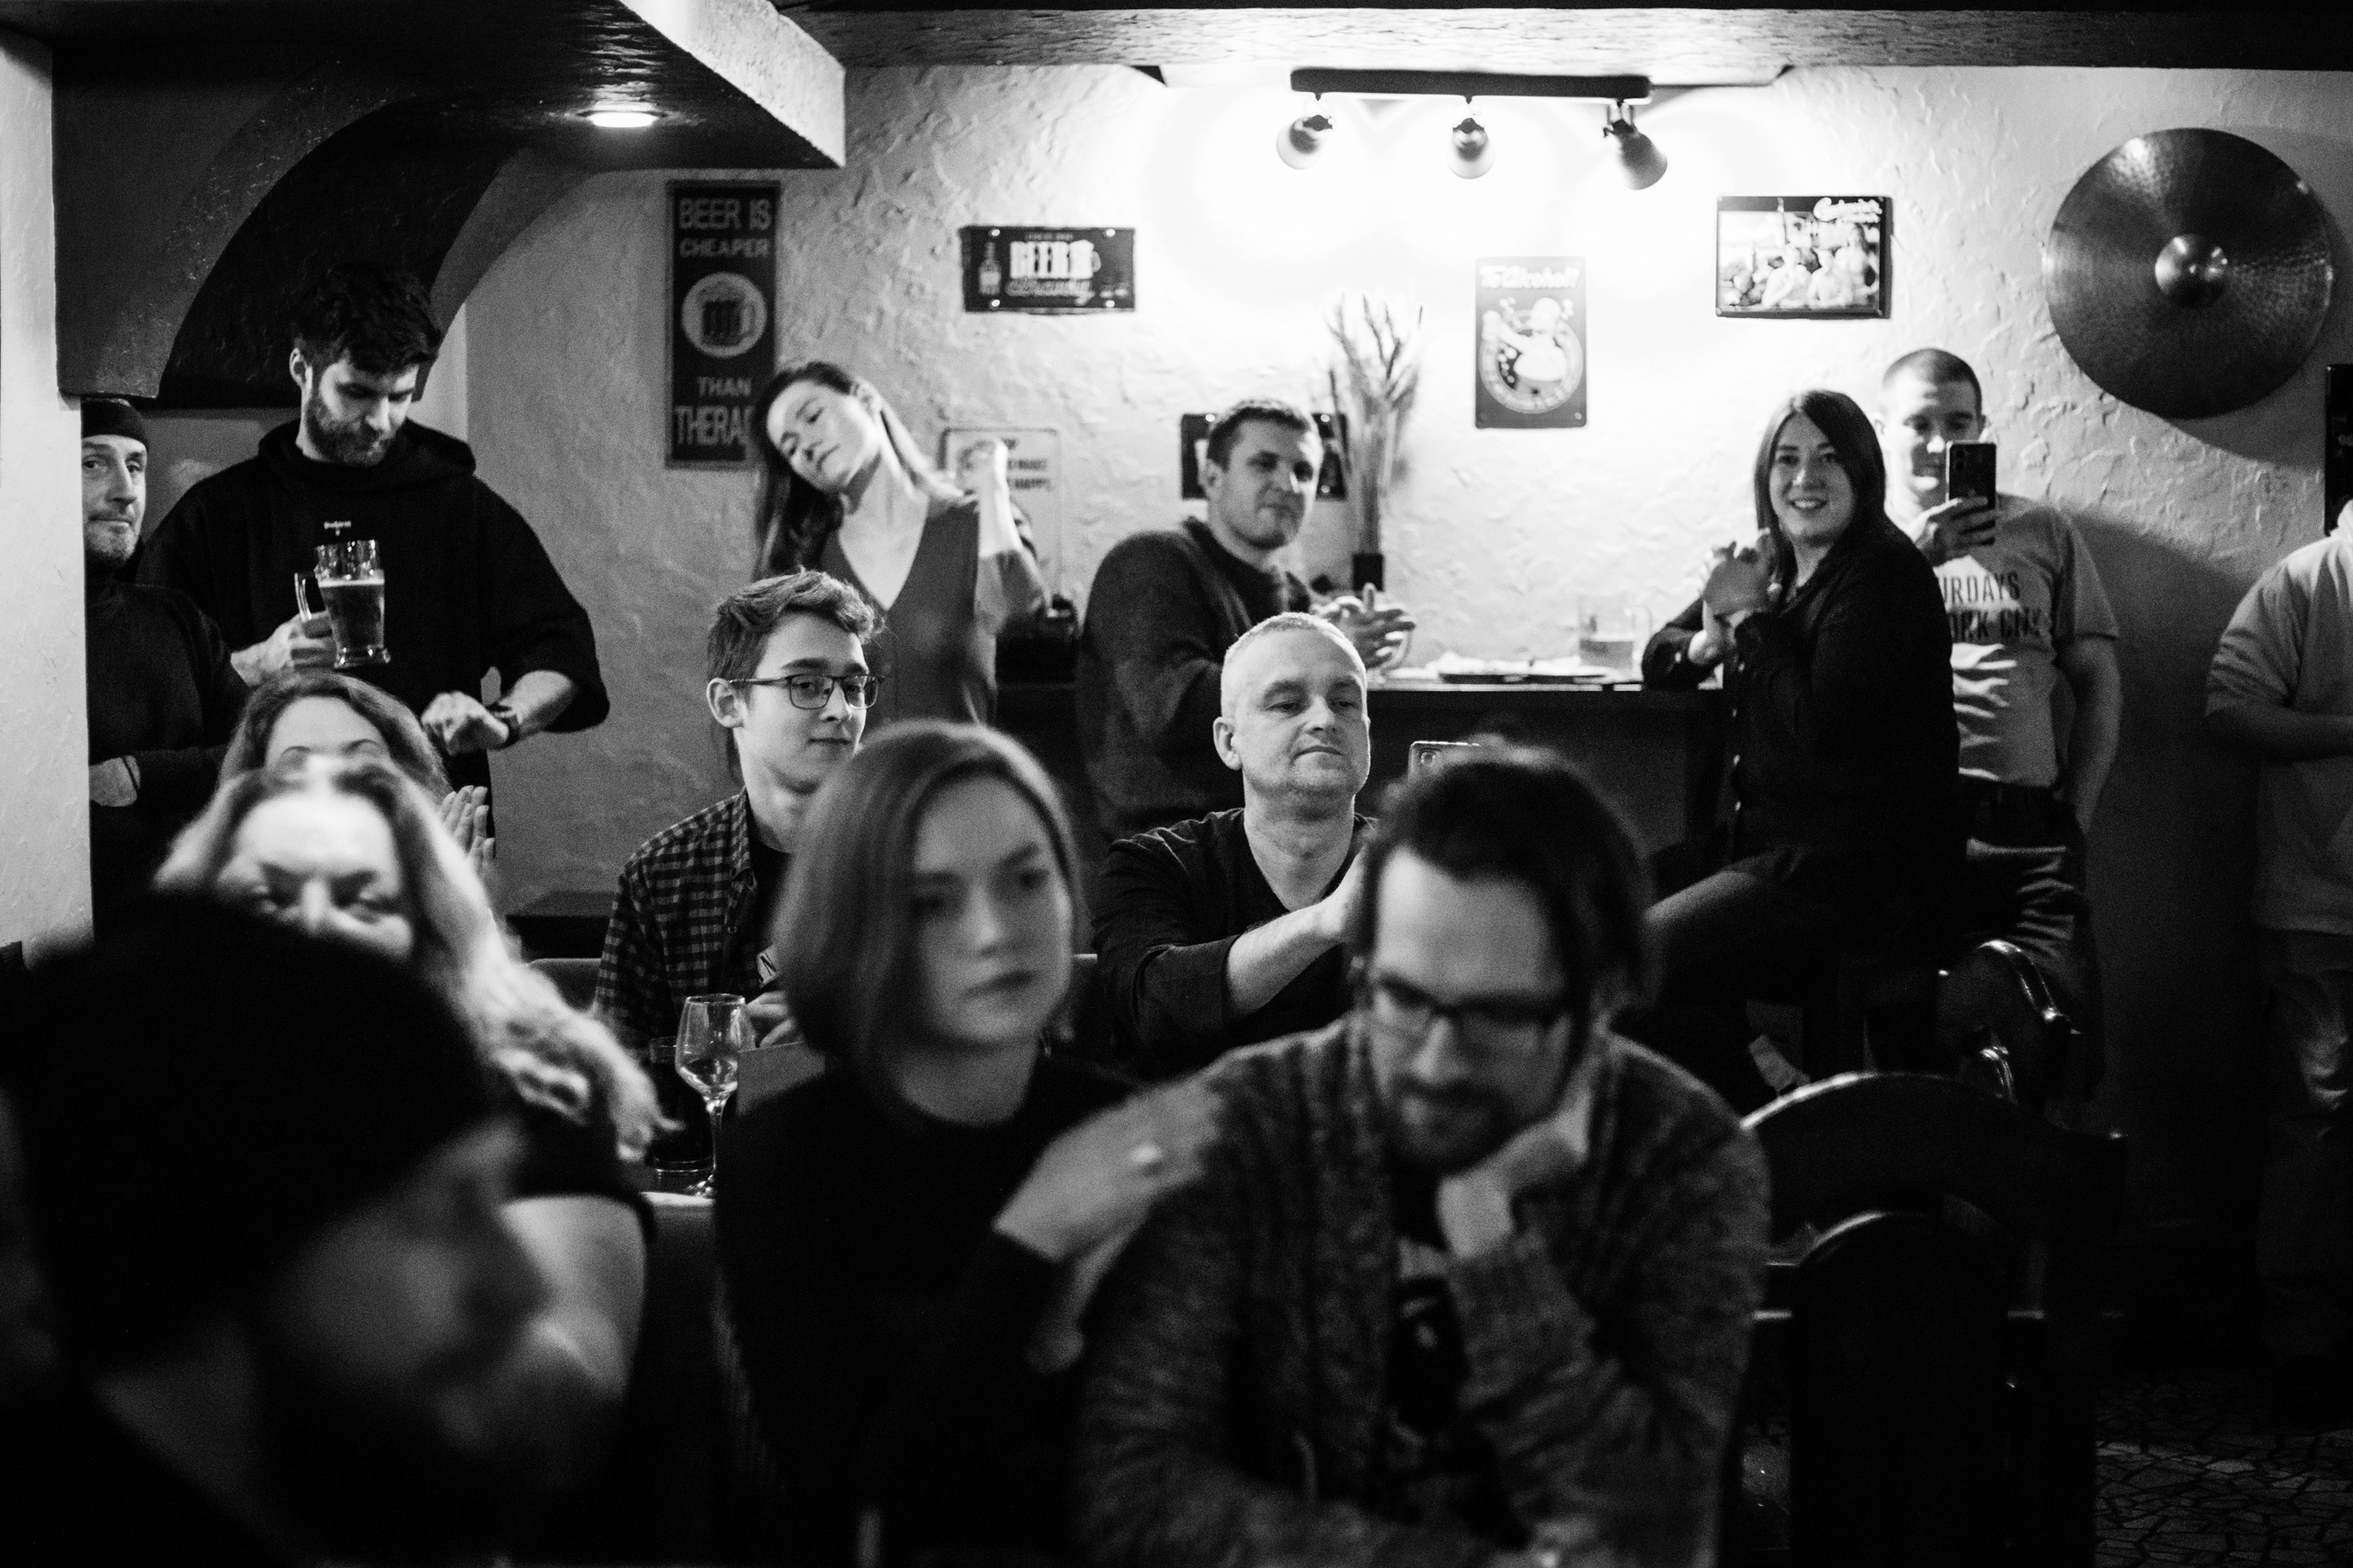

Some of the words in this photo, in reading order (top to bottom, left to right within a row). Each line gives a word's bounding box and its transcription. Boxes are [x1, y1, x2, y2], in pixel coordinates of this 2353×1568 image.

[678, 198, 741, 229] BEER
[749, 198, 772, 230] IS
[678, 238, 770, 258] CHEAPER
[698, 376, 752, 397] THAN
